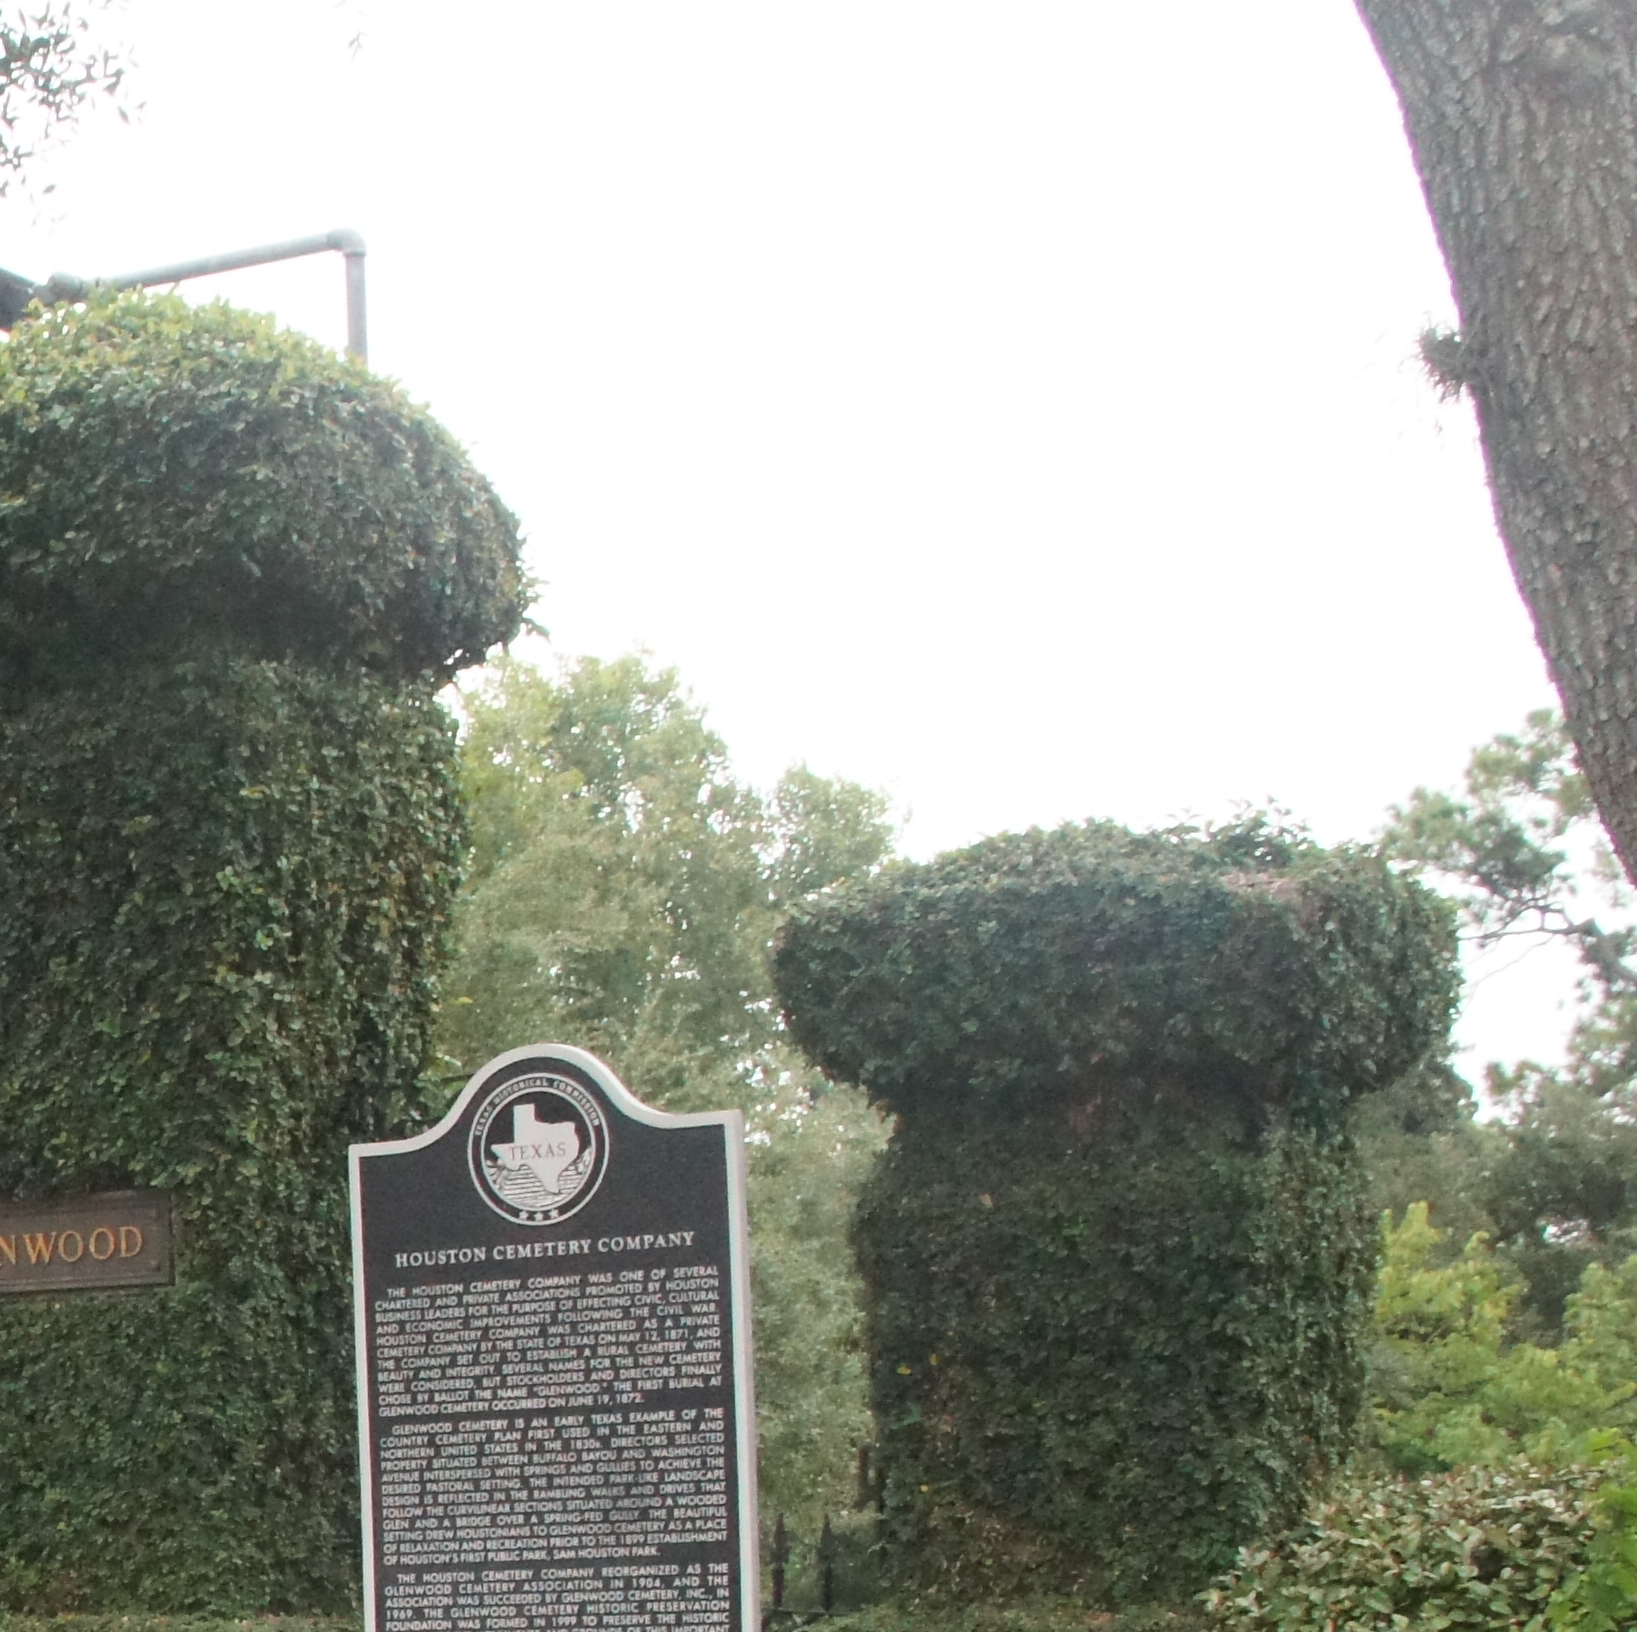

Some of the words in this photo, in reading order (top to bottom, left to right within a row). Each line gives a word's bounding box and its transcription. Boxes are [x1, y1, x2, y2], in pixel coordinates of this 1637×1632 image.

[509, 1142, 566, 1161] TEXAS
[395, 1246, 487, 1268] HOUSTON
[492, 1238, 591, 1261] CEMETERY
[598, 1231, 694, 1252] COMPANY
[375, 1297, 430, 1310] CHARTERED
[434, 1295, 457, 1306] AND
[462, 1292, 499, 1304] PRIVATE
[504, 1287, 580, 1301] ASSOCIATIONS
[585, 1282, 642, 1296] PROMOTED
[647, 1281, 660, 1292] BY
[665, 1277, 718, 1290] HOUSTON
[387, 1287, 405, 1297] THE
[412, 1283, 463, 1296] HOUSTON
[469, 1278, 520, 1292] CEMETERY
[527, 1274, 580, 1288] COMPANY
[587, 1272, 612, 1284] WAS
[619, 1270, 644, 1281] ONE
[650, 1268, 666, 1279] OF
[673, 1265, 718, 1278] SEVERAL
[376, 1323, 399, 1334] AND
[405, 1319, 462, 1332] ECONOMIC
[470, 1313, 551, 1327] IMPROVEMENTS
[558, 1308, 623, 1322] FOLLOWING
[629, 1306, 649, 1317] THE
[656, 1304, 683, 1316] CIVIL
[376, 1333, 426, 1345] HOUSTON
[432, 1329, 482, 1342] CEMETERY
[488, 1326, 540, 1338] COMPANY
[547, 1324, 570, 1335] WAS
[577, 1319, 636, 1333] CHARTERED
[643, 1318, 657, 1329] AS
[664, 1317, 673, 1327] A
[680, 1314, 719, 1326] PRIVATE
[377, 1345, 425, 1357] CEMETERY
[428, 1342, 477, 1354] COMPANY
[480, 1341, 493, 1351] BY
[495, 1340, 513, 1350] THE
[516, 1338, 543, 1349] STATE
[547, 1337, 561, 1347] OF
[564, 1334, 595, 1346] TEXAS
[597, 1333, 616, 1344] ON
[618, 1332, 640, 1342] MAY
[696, 1327, 720, 1338] AND
[377, 1359, 395, 1369] THE
[400, 1355, 450, 1368] COMPANY
[456, 1354, 473, 1364] SET
[479, 1352, 500, 1363] OUT
[506, 1351, 520, 1361] TO
[526, 1347, 577, 1360] ESTABLISH
[583, 1347, 590, 1357] A
[597, 1344, 628, 1356] RURAL
[635, 1341, 686, 1354] CEMETERY
[693, 1339, 721, 1350] WITH
[377, 1369, 413, 1381] BEAUTY
[418, 1368, 441, 1378] AND
[502, 1361, 543, 1373] SEVERAL
[548, 1359, 585, 1371] NAMES
[590, 1358, 610, 1368] FOR
[615, 1356, 633, 1367] THE
[638, 1354, 664, 1366] NEW
[669, 1351, 721, 1364] CEMETERY
[378, 1382, 404, 1393] WERE
[482, 1376, 501, 1387] BUT
[506, 1371, 584, 1385] STOCKHOLDERS
[590, 1369, 614, 1381] AND
[619, 1366, 675, 1379] DIRECTORS
[681, 1363, 722, 1375] FINALLY
[378, 1393, 411, 1404] CHOSE
[417, 1392, 428, 1402] BY
[434, 1390, 469, 1401] BALLOT
[474, 1388, 492, 1399] THE
[497, 1386, 527, 1398] NAME
[613, 1381, 632, 1391] THE
[637, 1379, 663, 1390] FIRST
[669, 1376, 704, 1388] BURIAL
[709, 1375, 721, 1386] AT
[380, 1435, 428, 1447] COUNTRY
[435, 1432, 486, 1444] CEMETERY
[494, 1430, 521, 1441] PLAN
[527, 1428, 555, 1439] FIRST
[562, 1427, 590, 1438] USED
[597, 1426, 609, 1436] IN
[616, 1424, 635, 1435] THE
[643, 1421, 691, 1434] EASTERN
[699, 1420, 724, 1431] AND
[392, 1422, 452, 1434] GLENWOOD
[458, 1419, 508, 1431] CEMETERY
[514, 1418, 524, 1428] IS
[530, 1417, 547, 1427] AN
[554, 1415, 584, 1426] EARLY
[590, 1413, 622, 1424] TEXAS
[629, 1410, 675, 1422] EXAMPLE
[681, 1409, 696, 1419] OF
[703, 1407, 723, 1418] THE
[381, 1459, 427, 1470] PROPERTY
[432, 1456, 477, 1468] SITUATED
[481, 1454, 528, 1466] BETWEEN
[532, 1452, 577, 1463] BUFFALO
[581, 1450, 616, 1461] BAYOU
[621, 1448, 645, 1459] AND
[651, 1445, 724, 1458] WASHINGTON
[384, 1584, 452, 1596] GLENWOOD
[458, 1582, 515, 1593] CEMETERY
[522, 1579, 602, 1591] ASSOCIATION
[610, 1578, 623, 1589] IN
[672, 1576, 700, 1587] AND
[707, 1575, 728, 1586] THE
[396, 1573, 416, 1583] THE
[422, 1571, 474, 1582] HOUSTON
[481, 1569, 533, 1580] CEMETERY
[540, 1567, 594, 1579] COMPANY
[601, 1564, 679, 1577] REORGANIZED
[686, 1563, 701, 1574] AS
[708, 1563, 728, 1573] THE
[385, 1596, 453, 1607] ASSOCIATION
[456, 1595, 479, 1605] WAS
[483, 1593, 542, 1604] SUCCEEDED
[545, 1592, 557, 1603] BY
[561, 1590, 624, 1602] GLENWOOD
[716, 1587, 729, 1598] IN
[423, 1608, 443, 1618] THE
[450, 1606, 516, 1617] GLENWOOD
[523, 1604, 579, 1615] CEMETERY
[586, 1602, 638, 1614] HISTORIC
[646, 1600, 729, 1612] PRESERVATION
[385, 1619, 452, 1631] FOUNDATION
[457, 1618, 480, 1629] WAS
[486, 1617, 528, 1628] FORMED
[533, 1617, 545, 1627] IN
[552, 1616, 577, 1626] 1999
[582, 1615, 597, 1625] TO
[602, 1614, 650, 1625] PRESERVE
[656, 1613, 675, 1624] THE
[682, 1612, 729, 1623] HISTORIC
